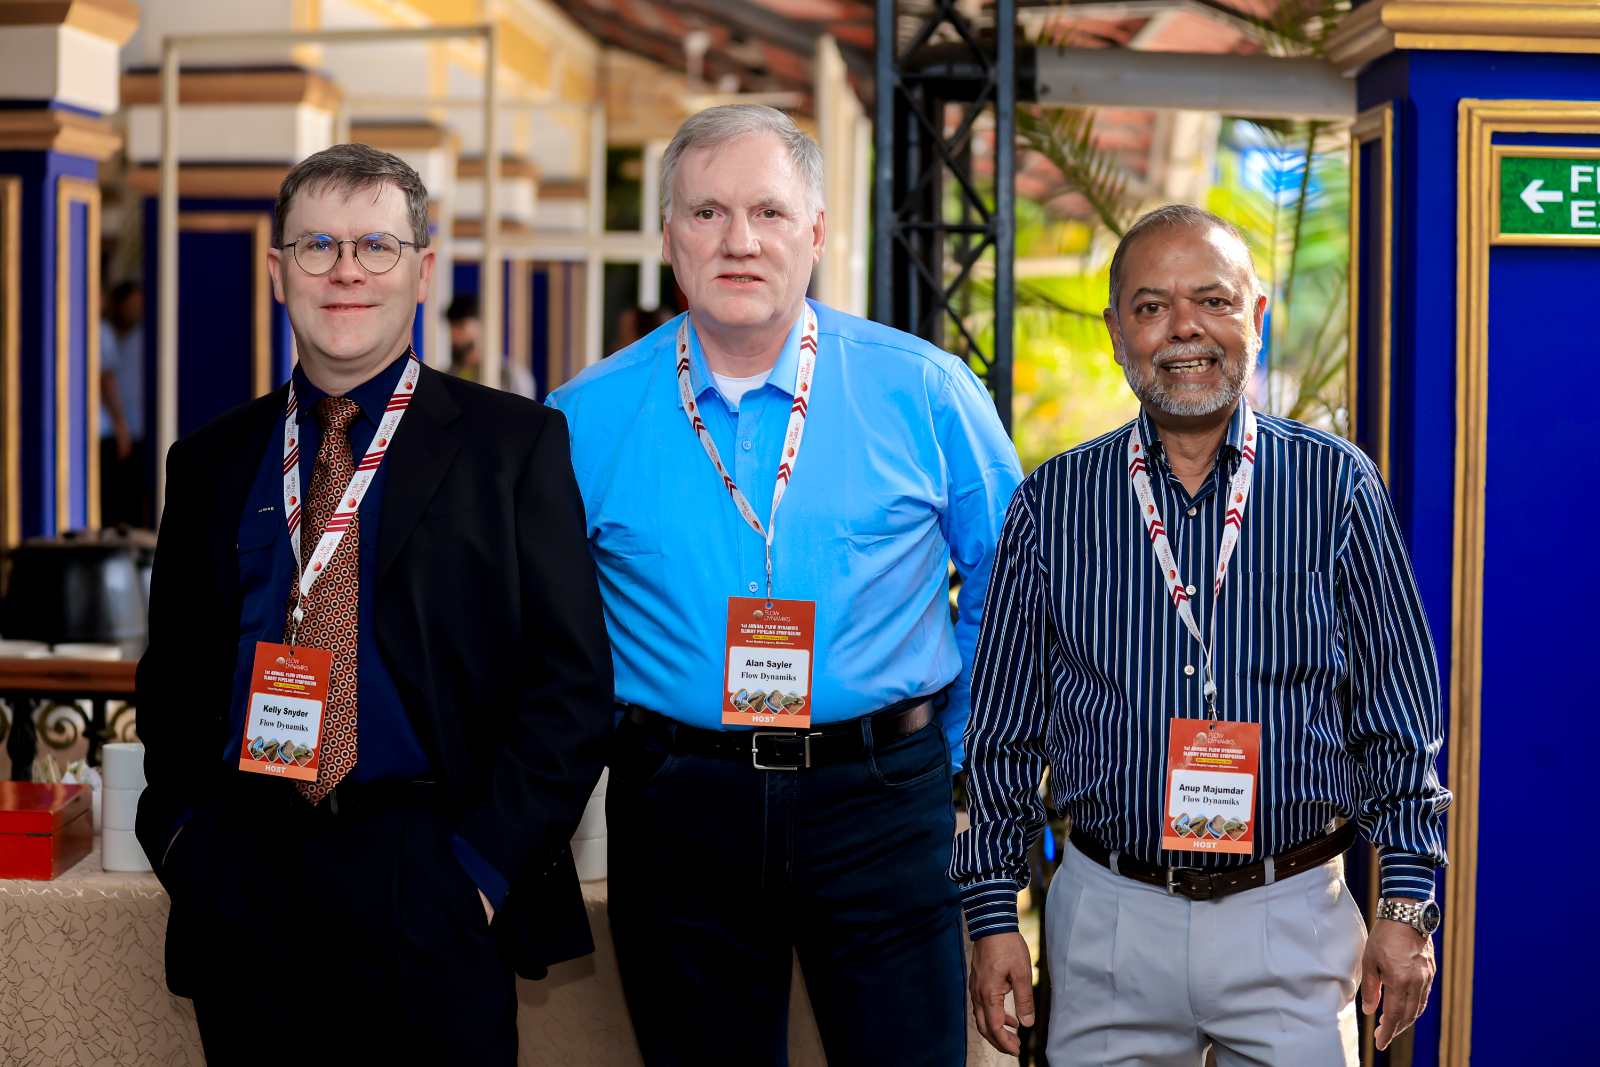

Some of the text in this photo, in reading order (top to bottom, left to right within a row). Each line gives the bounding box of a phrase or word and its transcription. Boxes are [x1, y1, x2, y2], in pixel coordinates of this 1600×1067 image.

[1571, 200, 1600, 228] E
[379, 424, 389, 438] FLOW
[384, 415, 398, 439] DYNAMIKS
[349, 482, 359, 497] FLOW
[354, 475, 369, 500] DYNAMIKS
[316, 544, 327, 560] FLOW
[320, 537, 337, 562] DYNAMIKS
[285, 663, 308, 671] DYNAMIKS
[745, 659, 792, 669] Alan Sayler
[760, 673, 796, 681] Dynamiks
[263, 705, 308, 718] Kelly Snyder
[259, 719, 308, 732] Flow Dynamiks
[265, 765, 286, 774] HOST
[1179, 784, 1244, 795] Anup Majumdar
[1183, 795, 1239, 805] Flow Dynamiks
[1193, 841, 1217, 849] HOST
